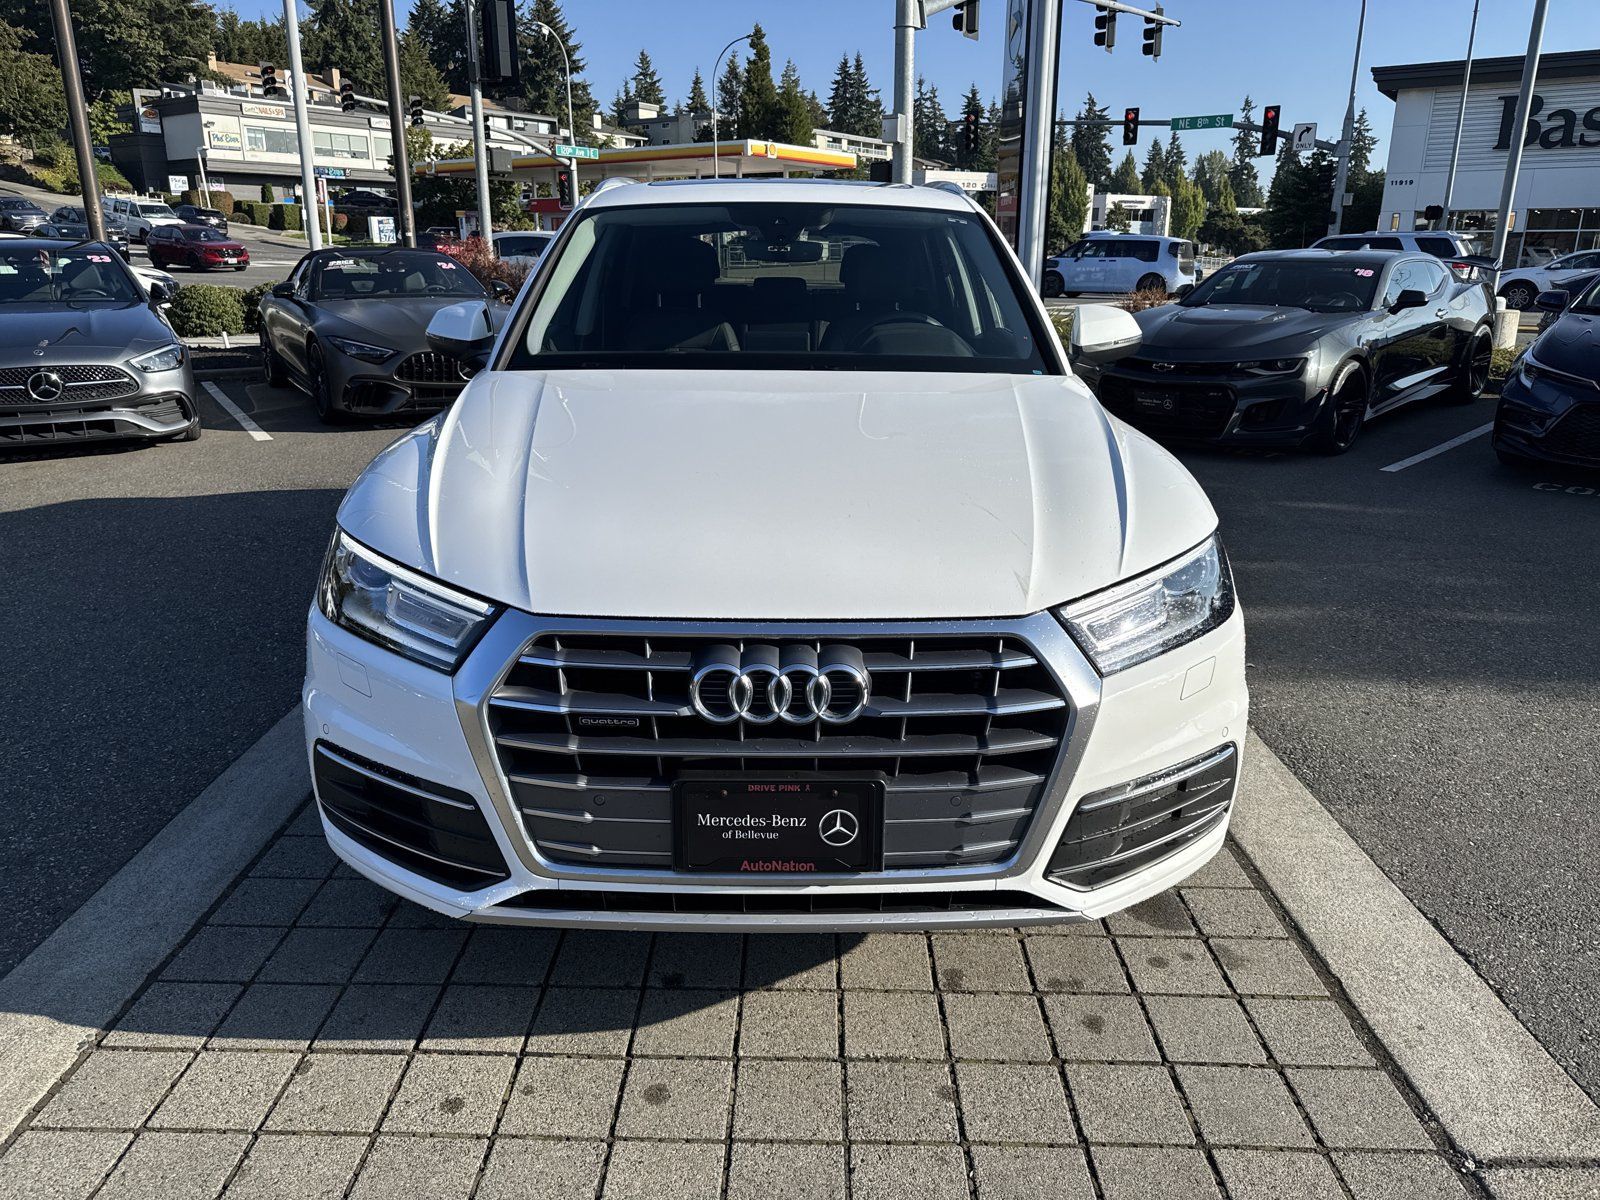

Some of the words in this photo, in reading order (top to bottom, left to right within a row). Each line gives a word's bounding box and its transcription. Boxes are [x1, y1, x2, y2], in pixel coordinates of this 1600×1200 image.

[1178, 118, 1191, 129] NE
[1196, 117, 1209, 128] 8th
[1215, 116, 1225, 127] St
[575, 148, 585, 157] Ave
[1532, 482, 1600, 496] CO
[581, 718, 636, 726] quattro
[747, 784, 776, 792] DRIVE
[778, 784, 801, 792] PINK
[697, 813, 807, 827] Mercedes-Benz
[722, 829, 733, 839] of
[735, 830, 779, 840] Bellevue
[740, 860, 815, 872] AutoNation
